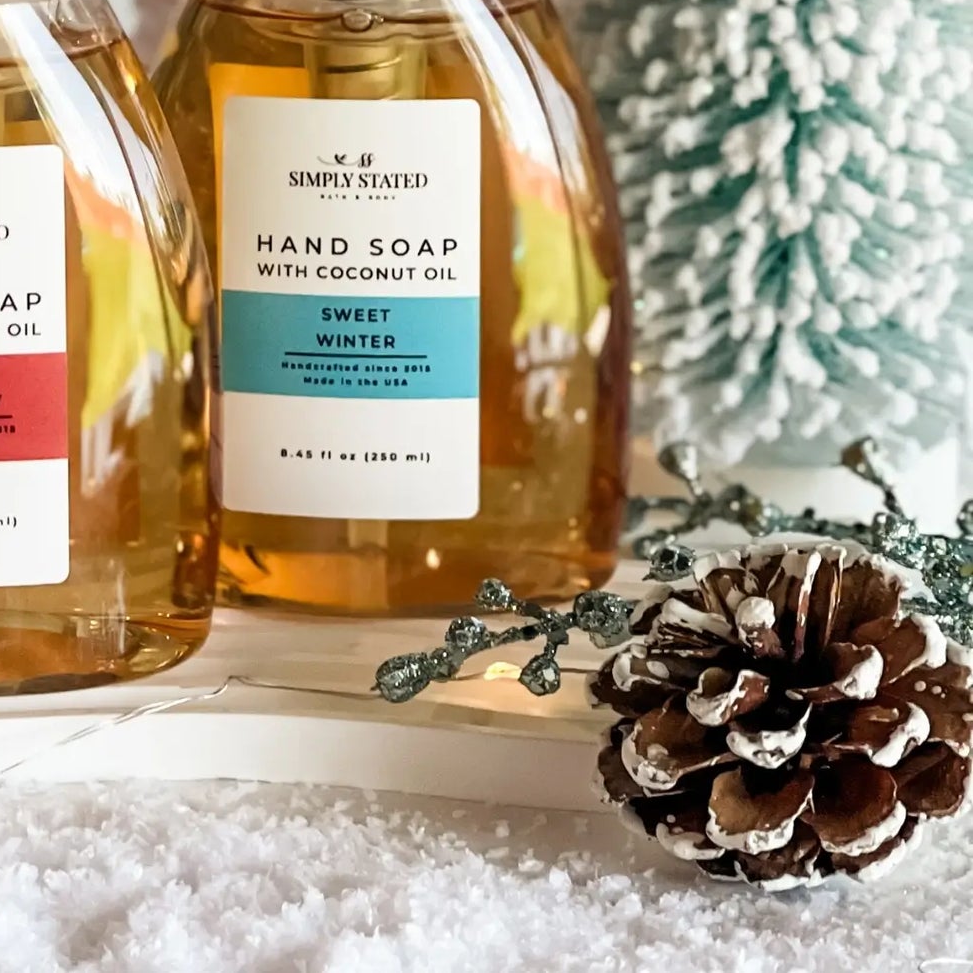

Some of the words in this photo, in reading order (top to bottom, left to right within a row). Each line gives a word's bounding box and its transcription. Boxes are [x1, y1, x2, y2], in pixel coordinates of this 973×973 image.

[289, 171, 354, 188] SIMPLY
[358, 173, 427, 189] STATED
[258, 234, 348, 255] HAND
[370, 239, 458, 256] SOAP
[257, 263, 307, 277] WITH
[317, 266, 416, 280] COCONUT
[424, 267, 457, 280] OIL
[322, 308, 391, 323] SWEET
[7, 323, 41, 336] OIL
[317, 333, 395, 349] WINTER
[282, 361, 359, 372] Handcrafted
[304, 377, 335, 385] Made
[341, 377, 352, 385] in
[358, 378, 378, 386] the
[384, 378, 408, 386] USA
[281, 449, 313, 459] 8.45
[321, 451, 331, 460] fl
[340, 452, 355, 461] oz
[364, 452, 397, 463] (250
[406, 452, 430, 463] ml)
